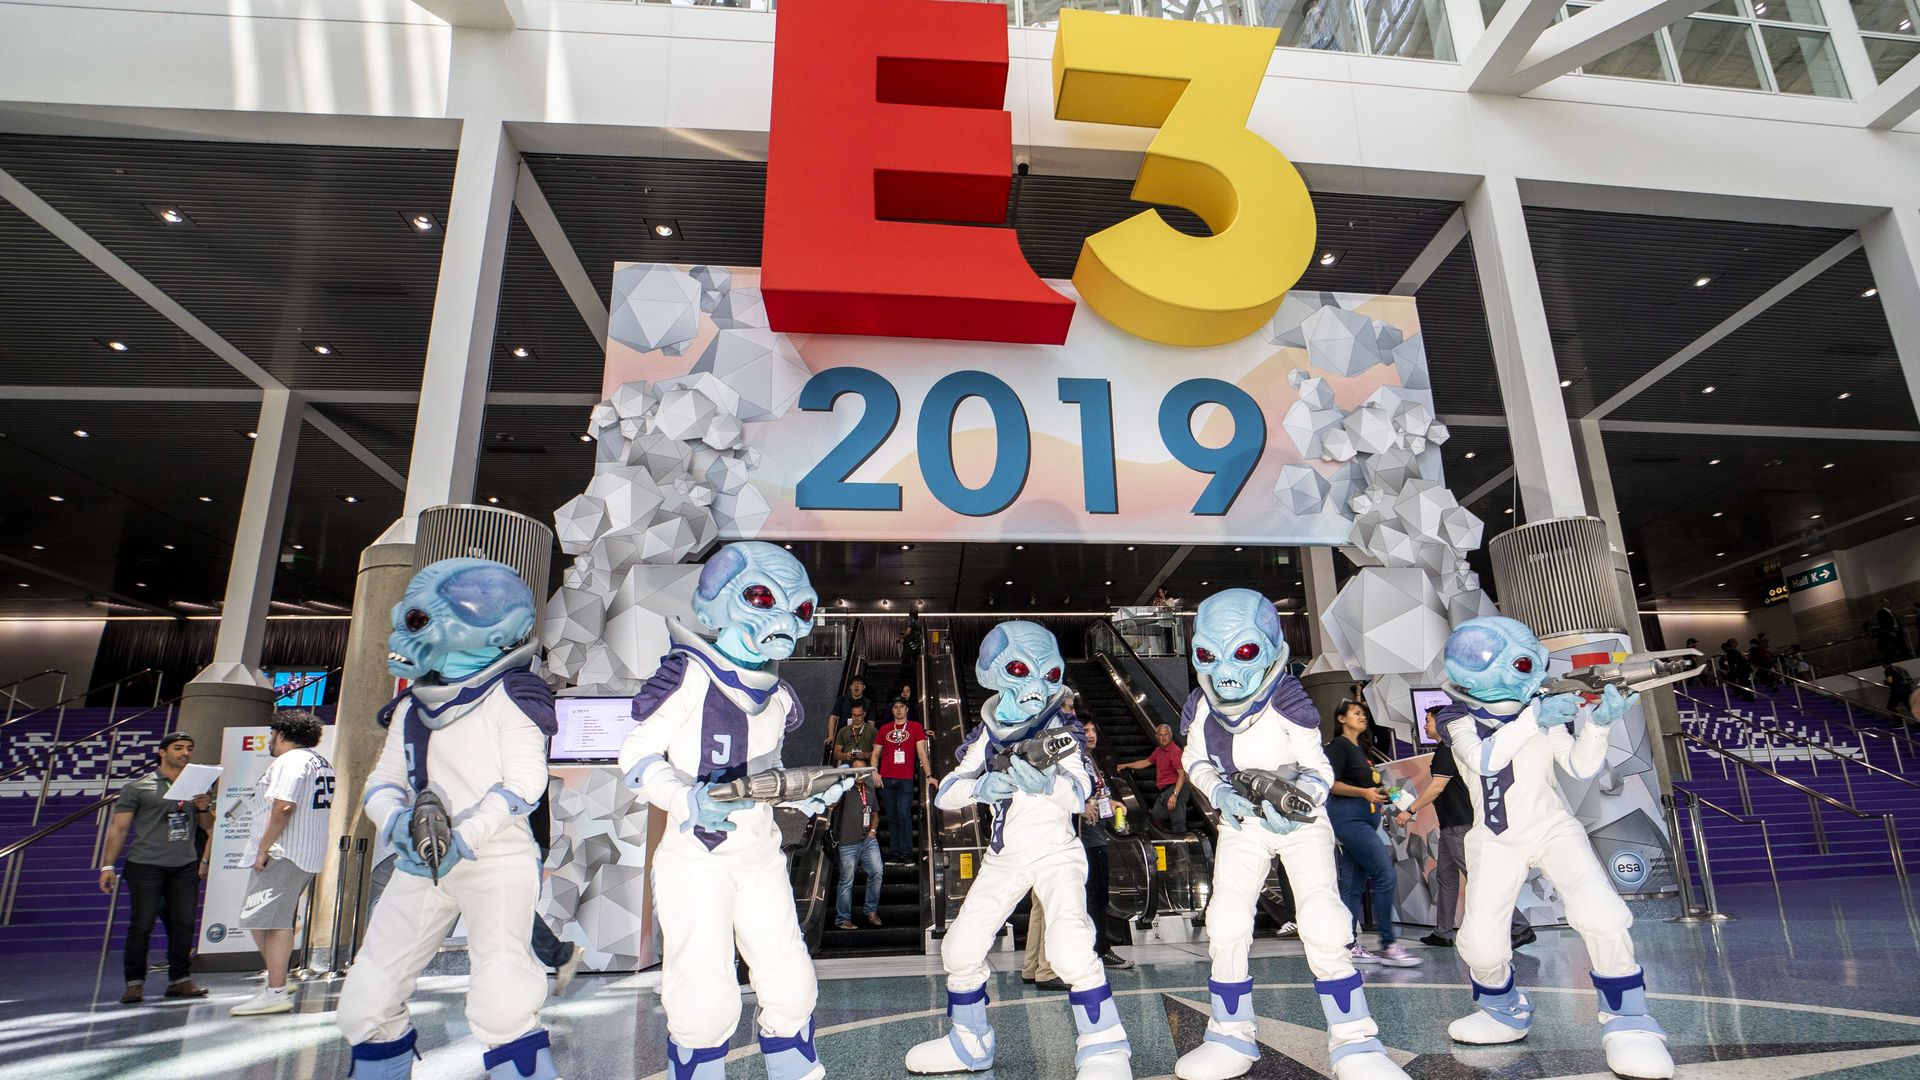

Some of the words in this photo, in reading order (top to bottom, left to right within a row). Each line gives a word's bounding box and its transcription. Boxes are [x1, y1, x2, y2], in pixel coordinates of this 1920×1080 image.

[760, 0, 1317, 348] E3
[795, 367, 1268, 518] 2019
[1792, 575, 1809, 589] Hall
[1811, 571, 1819, 582] K
[242, 735, 266, 751] E3
[312, 775, 336, 810] 25
[1617, 863, 1641, 873] esa
[245, 887, 274, 908] NIKE
